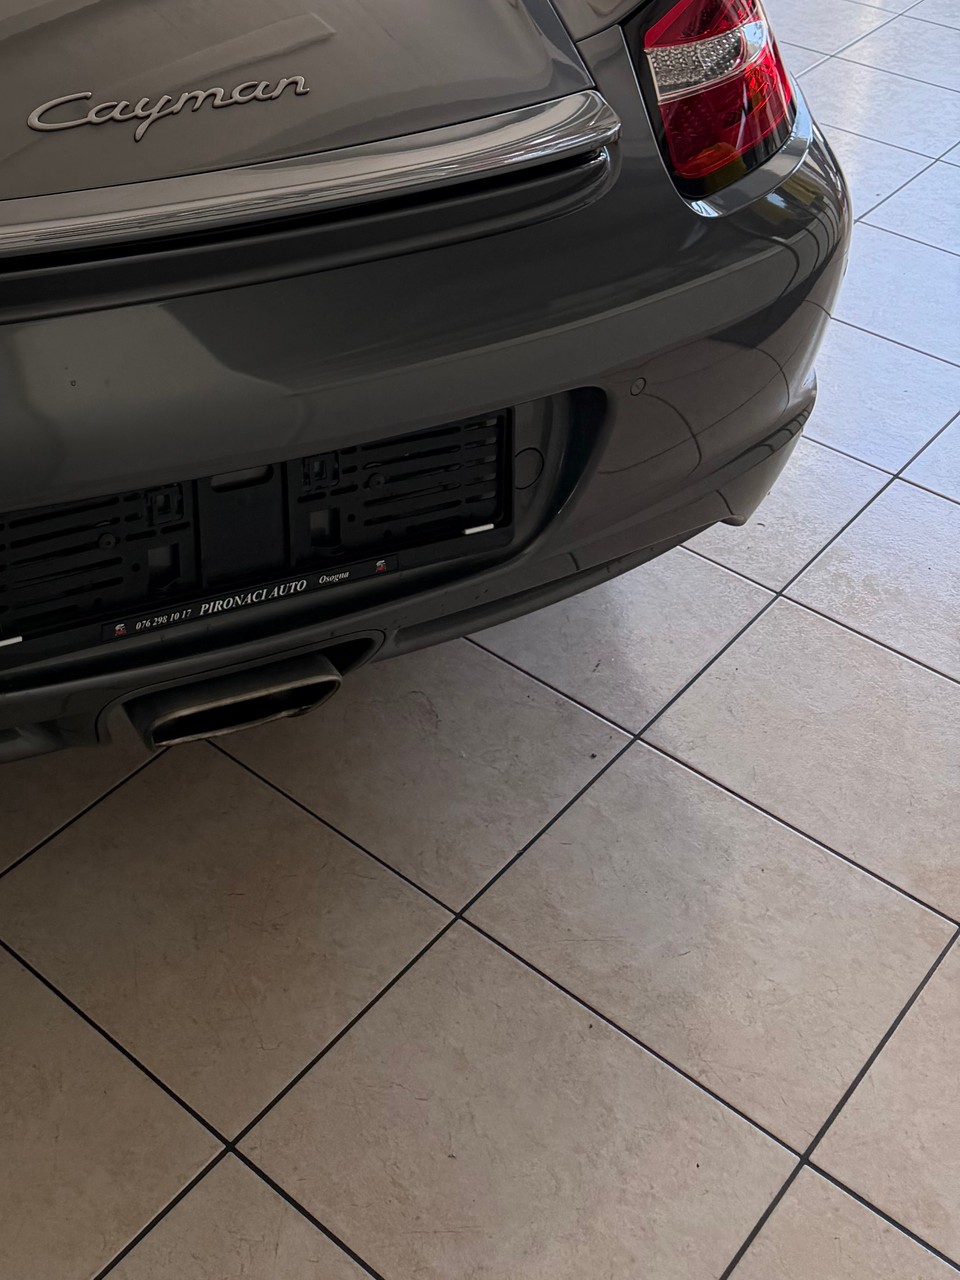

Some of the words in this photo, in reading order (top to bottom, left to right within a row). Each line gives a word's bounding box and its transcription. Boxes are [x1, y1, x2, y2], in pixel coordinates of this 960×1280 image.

[26, 75, 311, 142] Cayman
[135, 619, 151, 630] 076
[152, 615, 168, 626] 298
[170, 612, 180, 621] 10
[181, 609, 192, 619] 17
[199, 588, 267, 616] PIRONACI
[269, 579, 307, 599] AUTO
[318, 571, 350, 584] Osogna
